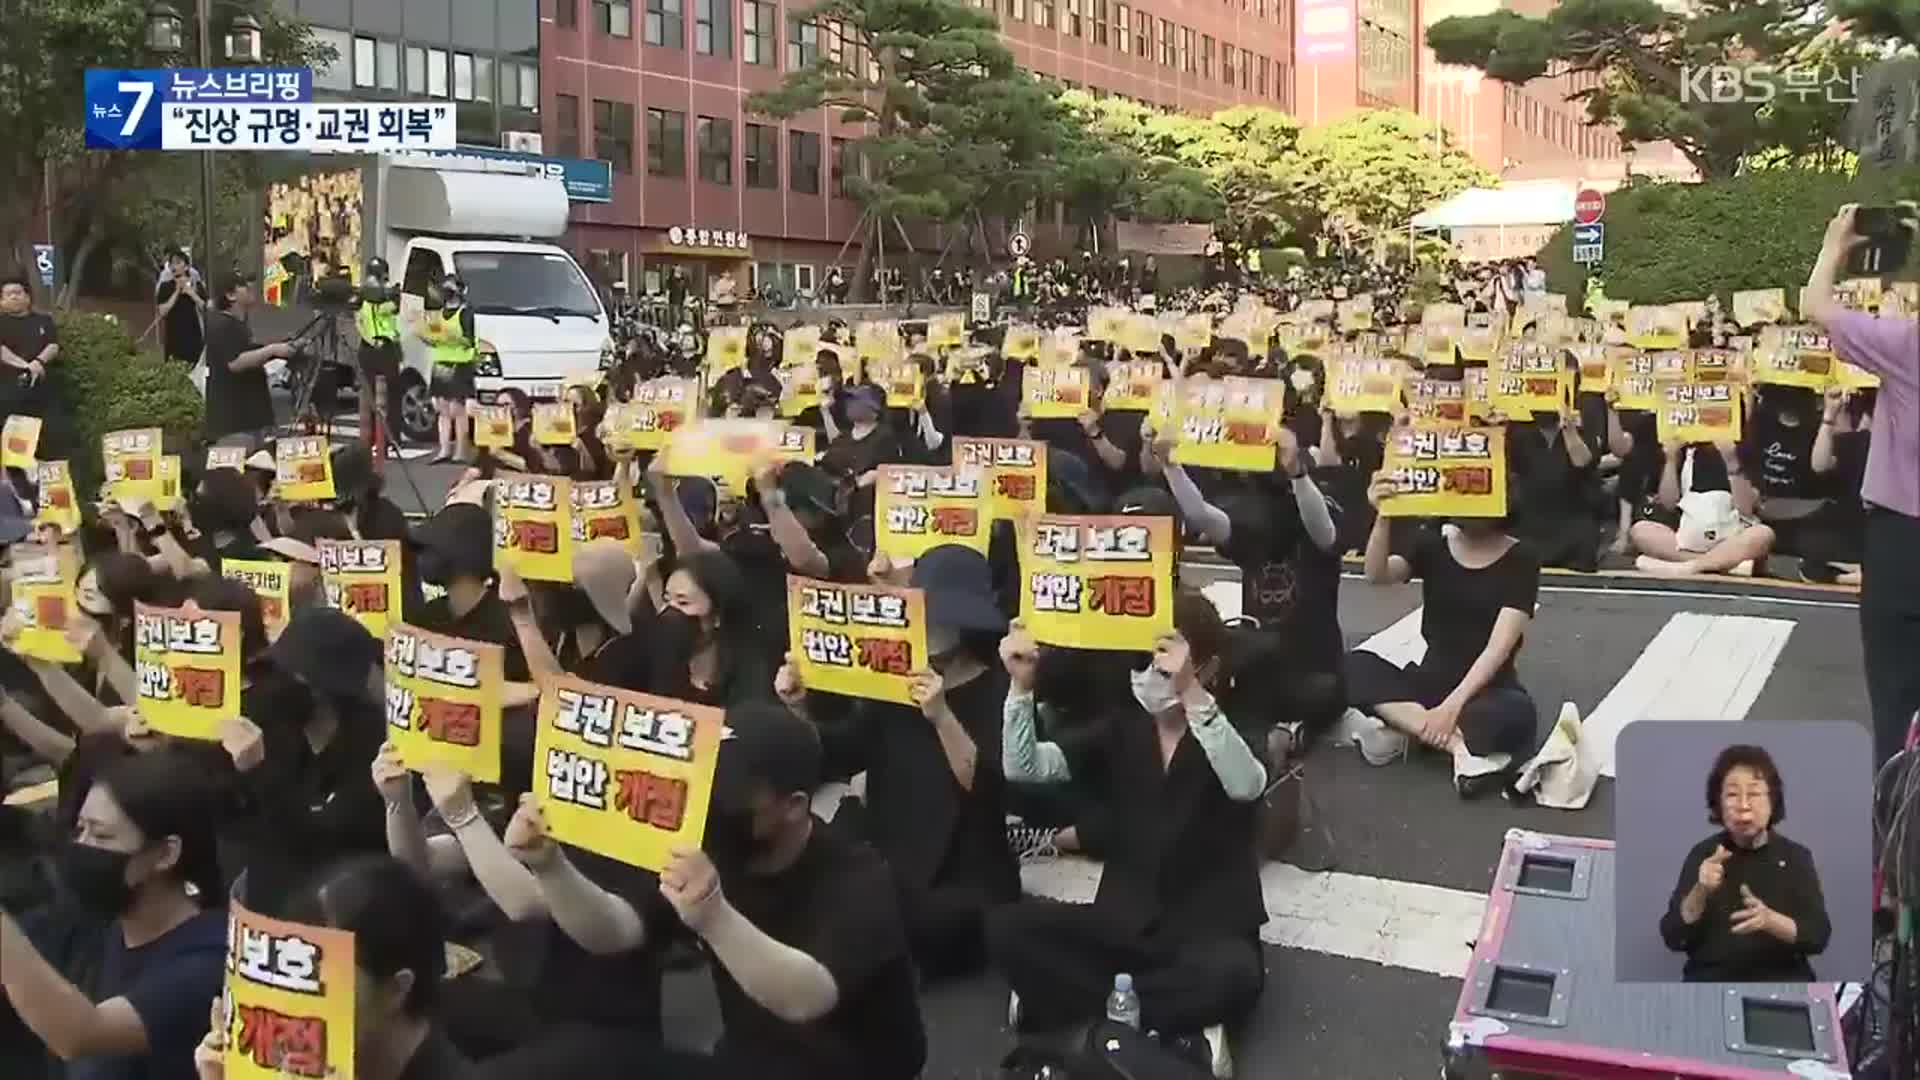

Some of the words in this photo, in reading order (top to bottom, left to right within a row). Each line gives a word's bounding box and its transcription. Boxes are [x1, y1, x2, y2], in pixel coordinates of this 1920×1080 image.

[996, 445, 1036, 468] 보호
[1438, 429, 1490, 459] 보호
[887, 469, 928, 498] 교권
[929, 472, 979, 498] 보호
[341, 544, 388, 573] 보호
[1034, 525, 1081, 563] 교권
[1084, 524, 1152, 561] 보호
[801, 586, 848, 625] 교권
[850, 592, 909, 628] 보호
[1032, 572, 1083, 614] 법안
[167, 615, 224, 655] 보호
[802, 627, 853, 667] 법안
[416, 640, 481, 689] 보호
[552, 688, 616, 748] 교권
[618, 703, 696, 762] 보호
[546, 747, 610, 811] 법안
[239, 923, 326, 997] 보호
